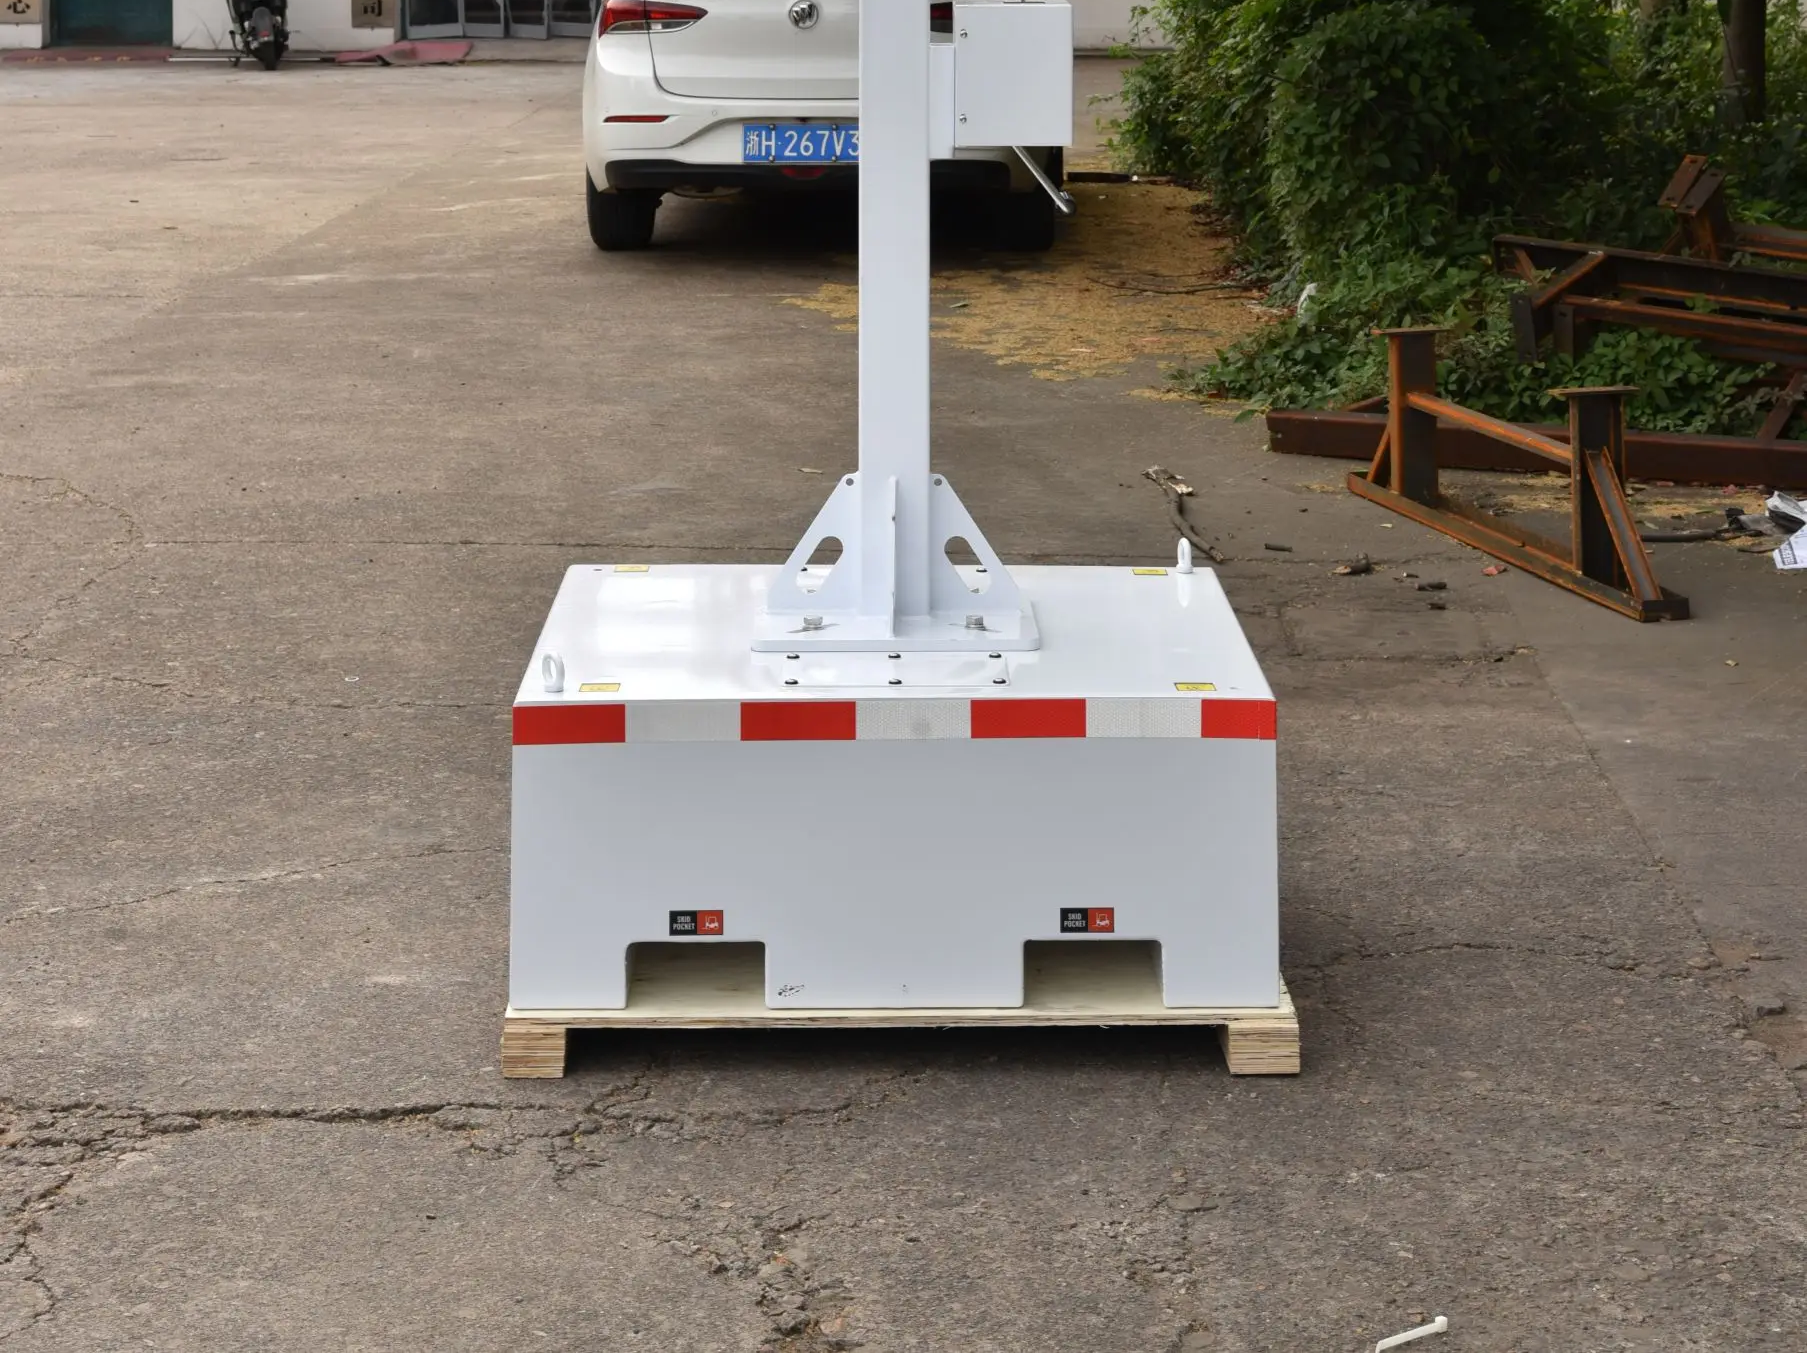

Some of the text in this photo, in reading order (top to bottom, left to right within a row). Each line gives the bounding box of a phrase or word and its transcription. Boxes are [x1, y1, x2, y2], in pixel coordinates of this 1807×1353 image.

[676, 915, 691, 923] SKID
[1067, 912, 1082, 920] SKID
[672, 923, 695, 931] POCKET
[1063, 920, 1086, 928] POCKET
